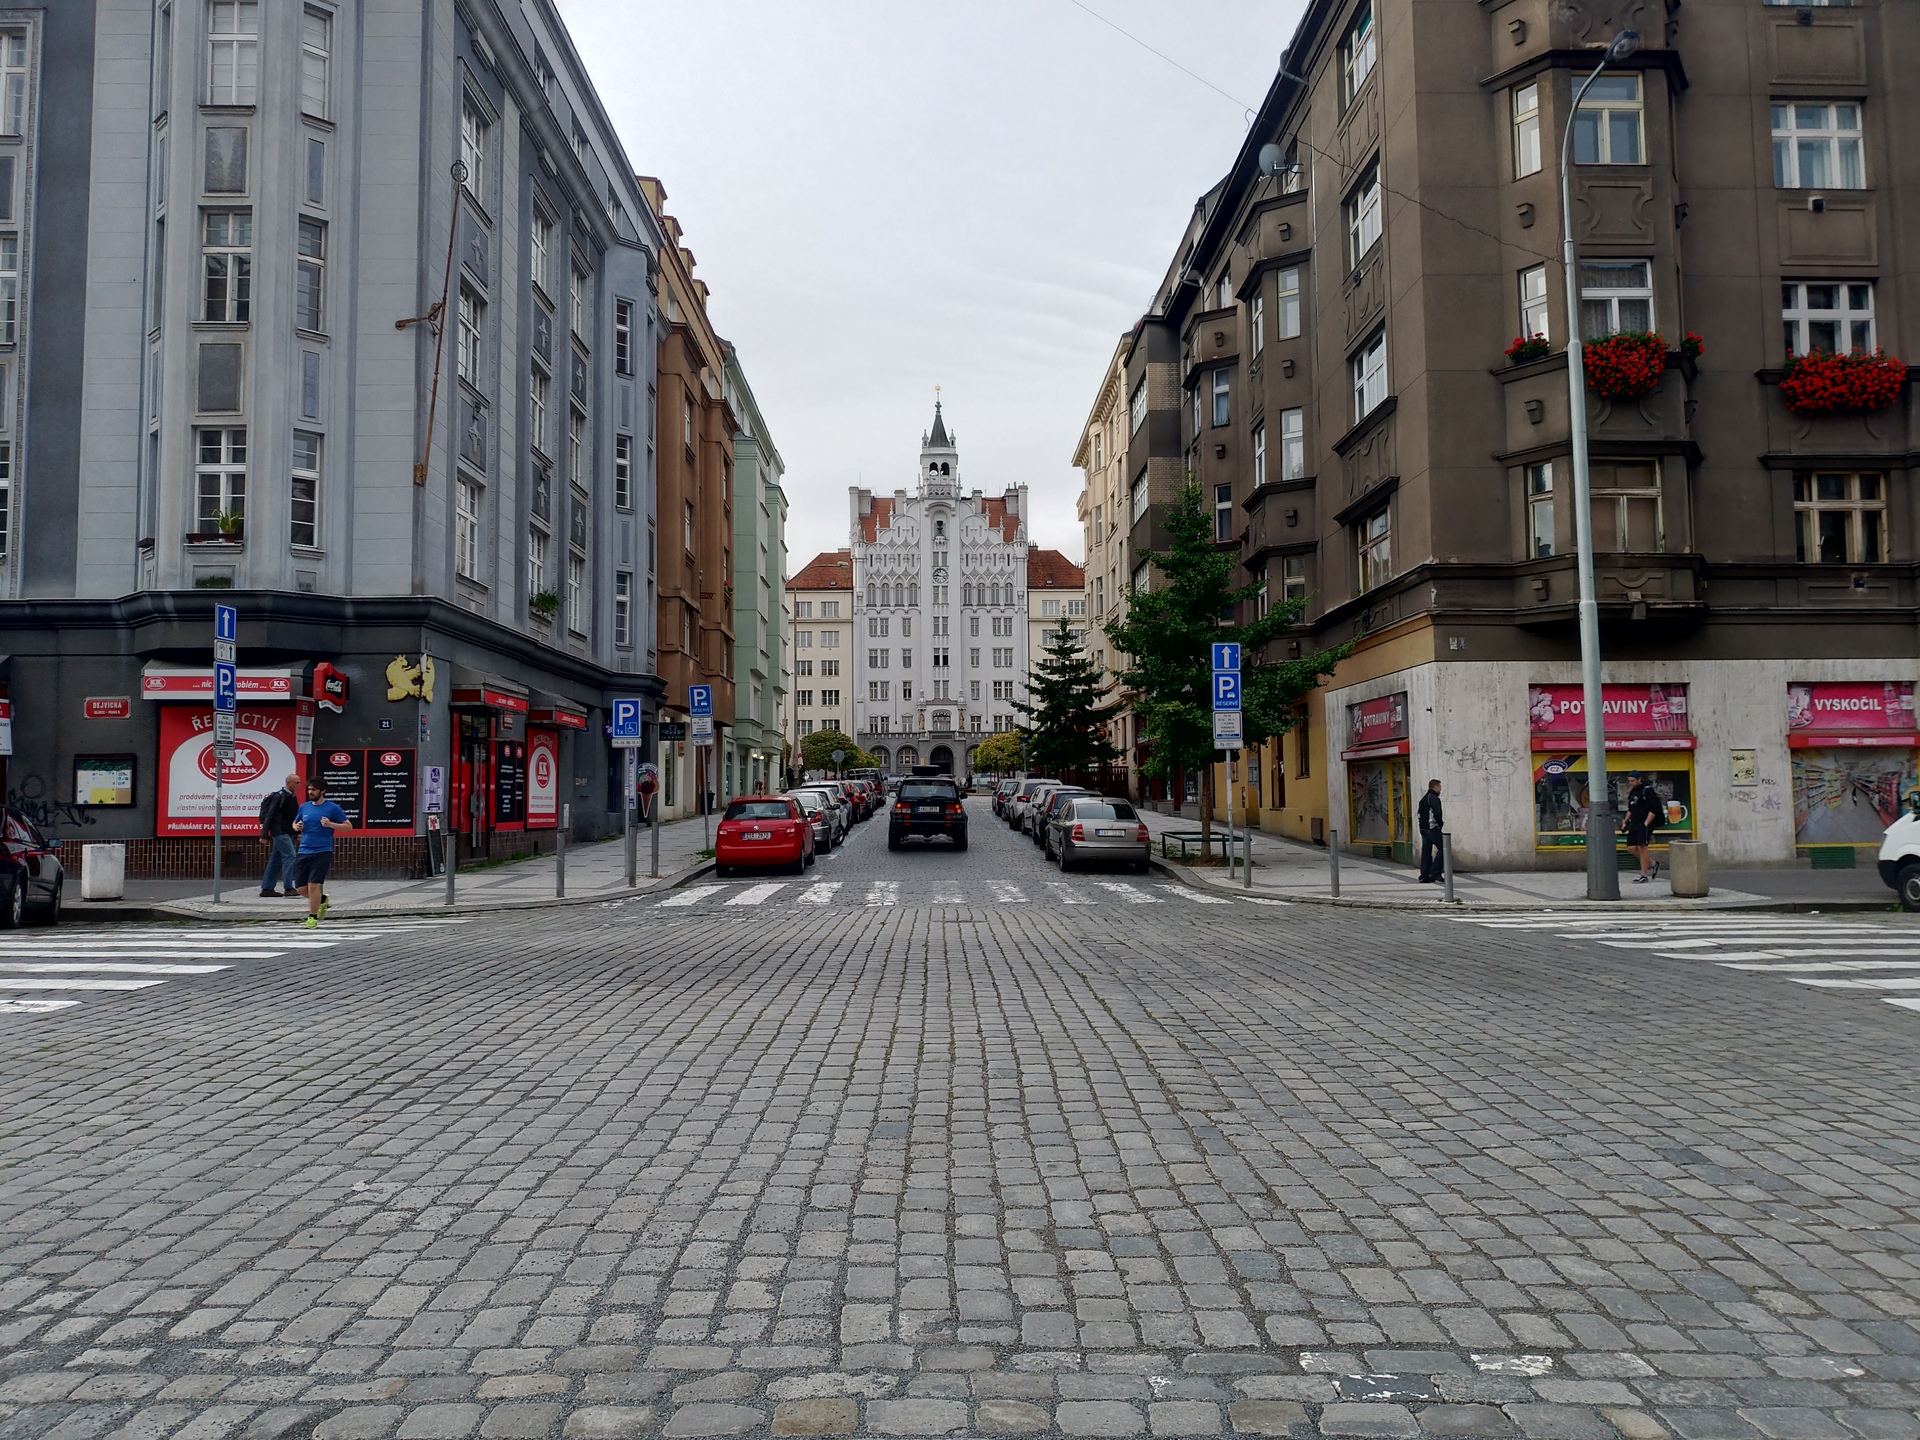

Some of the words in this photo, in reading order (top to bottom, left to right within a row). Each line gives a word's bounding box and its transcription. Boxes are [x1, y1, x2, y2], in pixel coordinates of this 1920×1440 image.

[219, 668, 232, 696] P
[1218, 676, 1235, 699] P
[92, 701, 123, 709] DEJVICKÁ
[693, 688, 707, 706] P
[1814, 696, 1882, 711] VYSKOČIL
[619, 703, 635, 726] P
[1560, 700, 1649, 714] POAVINY
[191, 715, 281, 732] ŘEICTVÍ
[1363, 711, 1390, 728] POTRAVINY
[209, 767, 229, 775] Moš
